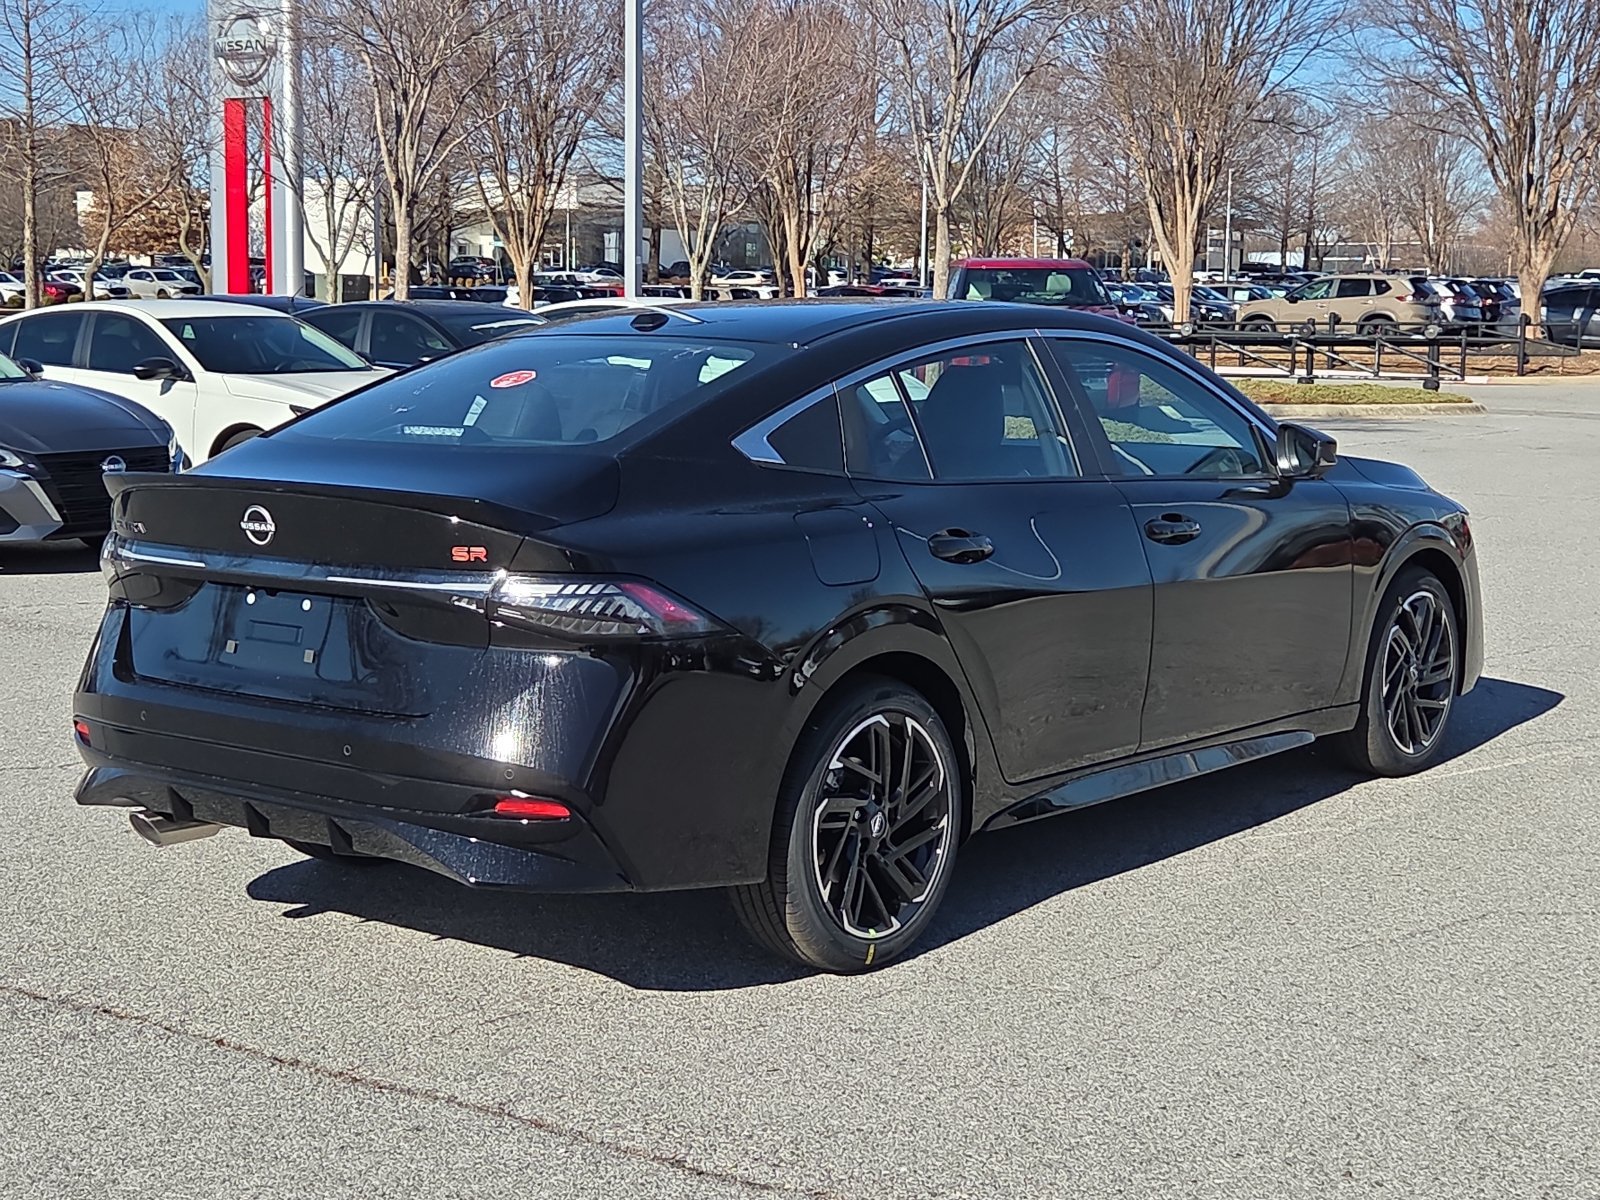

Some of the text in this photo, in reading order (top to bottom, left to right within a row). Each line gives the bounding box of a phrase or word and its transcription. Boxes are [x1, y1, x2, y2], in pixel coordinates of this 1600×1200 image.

[216, 39, 267, 53] NISSAN
[241, 521, 276, 532] NISSAN
[452, 546, 488, 562] SR
